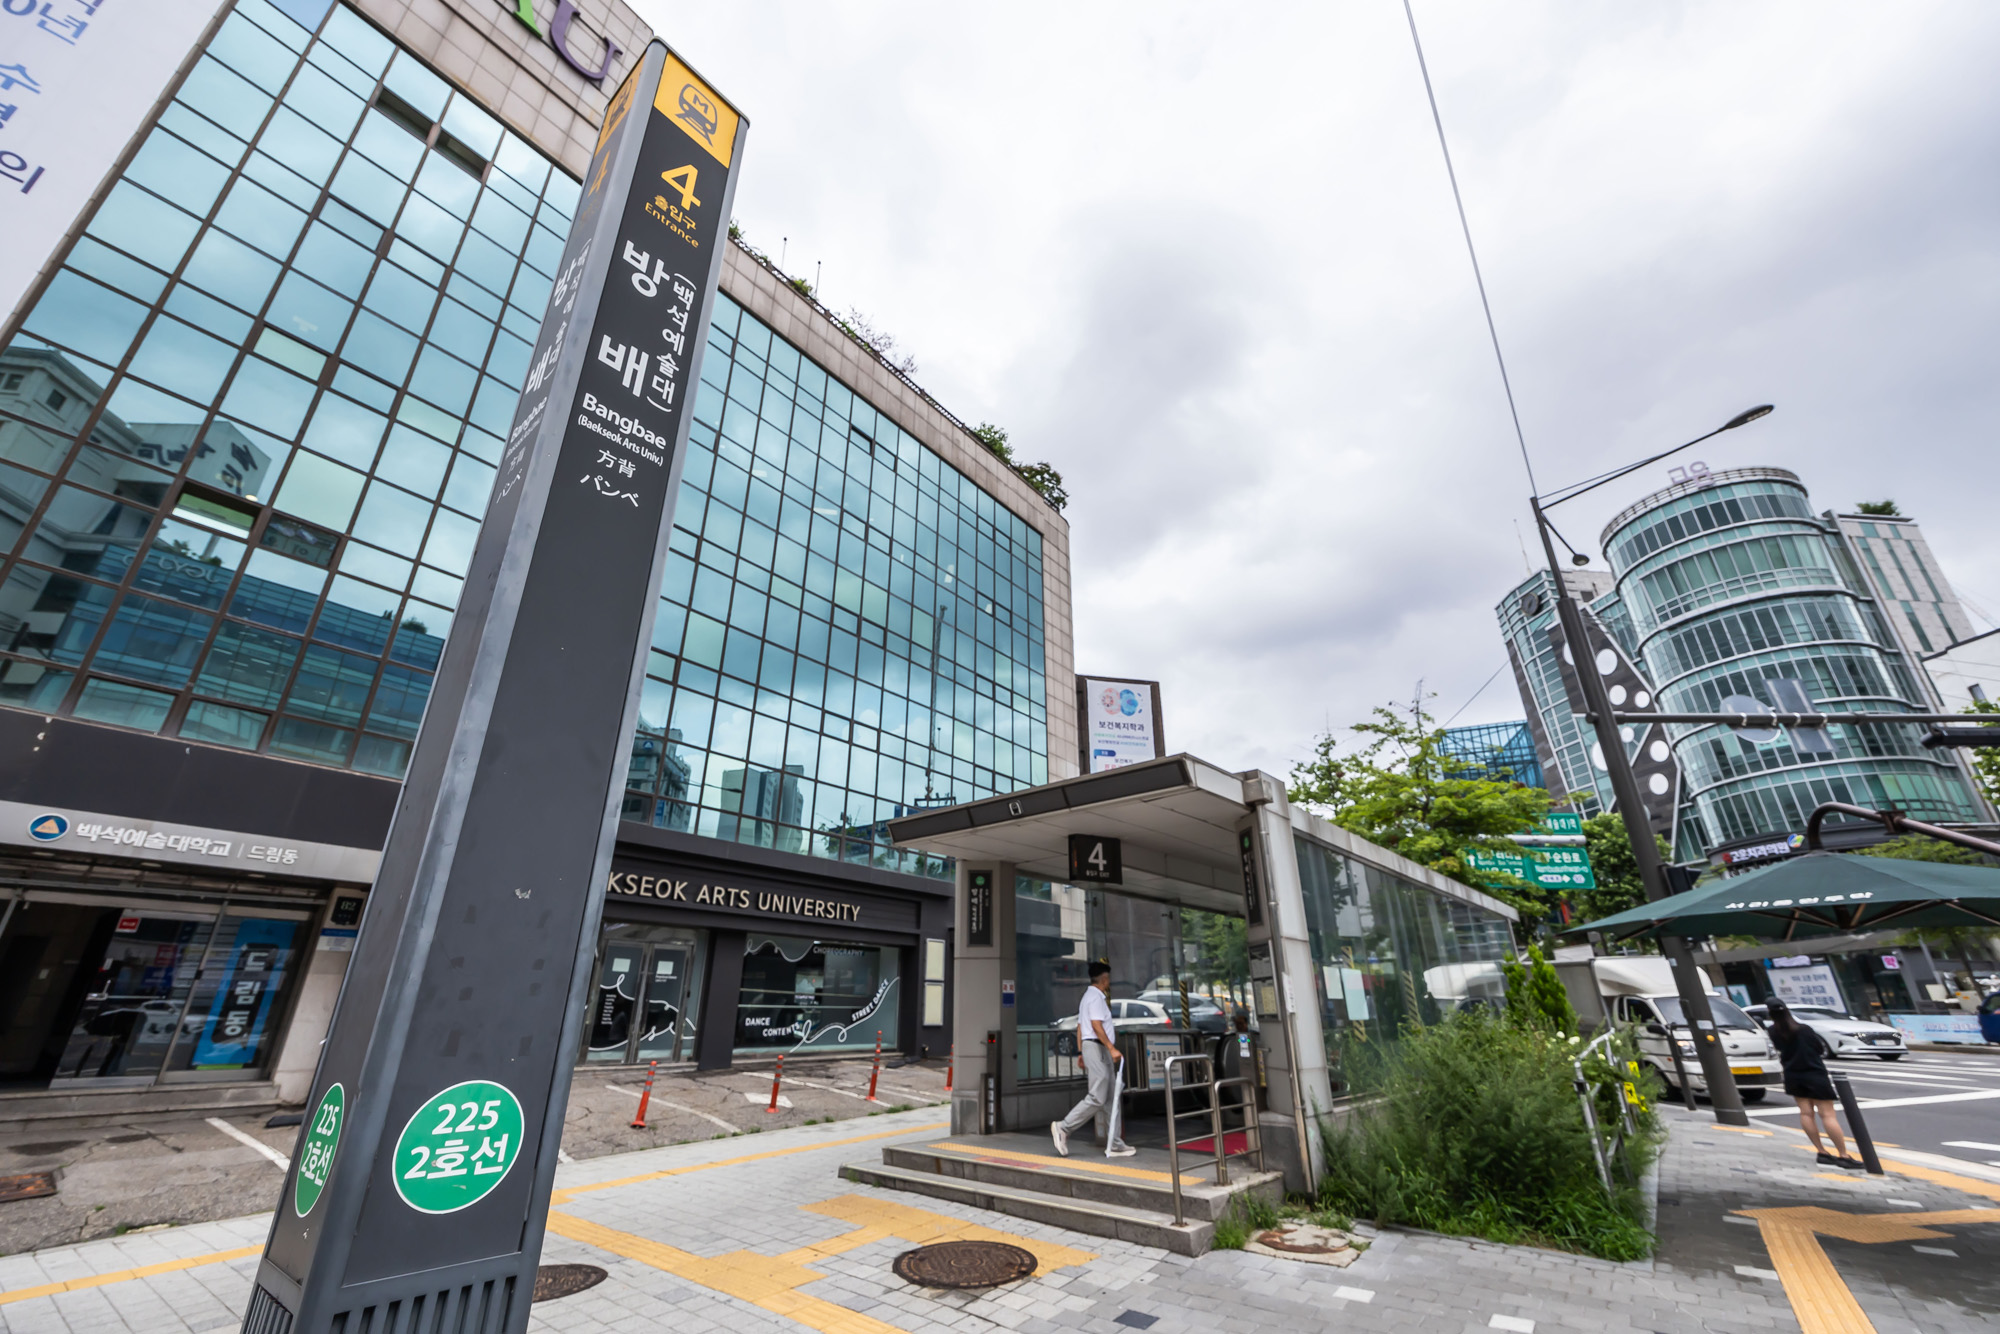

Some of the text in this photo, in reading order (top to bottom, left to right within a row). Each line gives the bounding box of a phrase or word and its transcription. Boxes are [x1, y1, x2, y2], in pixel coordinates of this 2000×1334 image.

[660, 163, 701, 211] 4
[644, 202, 700, 248] Entrance
[654, 194, 697, 231] 출입구
[582, 392, 667, 450] Bangbae
[577, 414, 664, 467] (Baekseok Arts Univ.)
[596, 449, 637, 479] 方背
[579, 474, 639, 508] パンベ
[1098, 721, 1145, 732] 보건복지학과
[75, 822, 300, 866] 백석예술대학교 드림동
[1088, 842, 1107, 872] 4
[696, 884, 751, 909] ARTS
[757, 892, 861, 922] UNIVERSITY
[223, 951, 269, 1037] 드림동
[851, 977, 889, 1022] STREET DANCE
[744, 1016, 771, 1027] DANCE
[762, 1022, 801, 1037] CONTENTS
[315, 1103, 340, 1137] 225
[431, 1099, 502, 1136] 225
[300, 1140, 334, 1188] 2호선
[403, 1133, 509, 1181] 2호선
